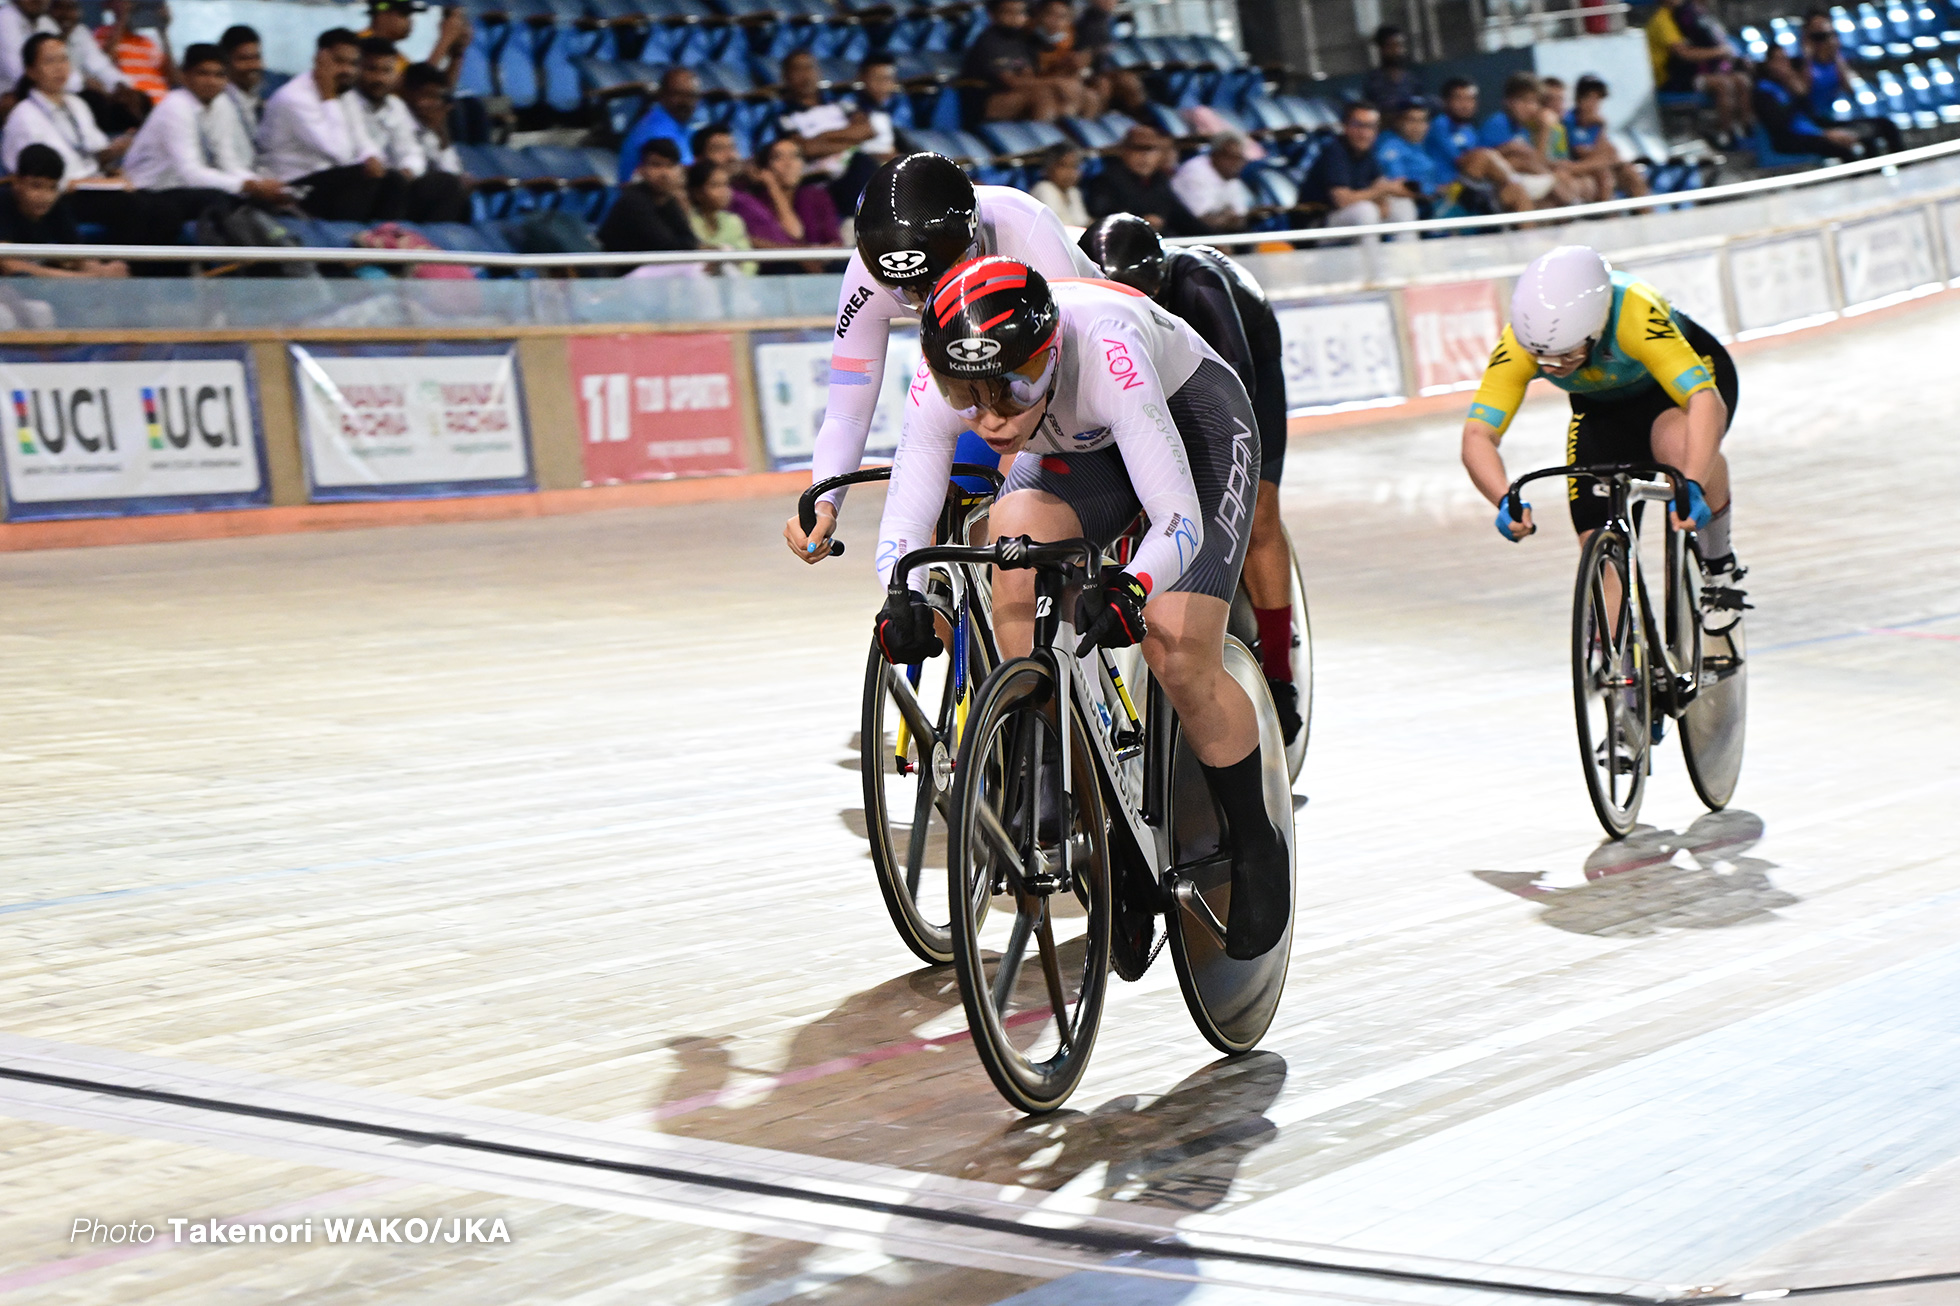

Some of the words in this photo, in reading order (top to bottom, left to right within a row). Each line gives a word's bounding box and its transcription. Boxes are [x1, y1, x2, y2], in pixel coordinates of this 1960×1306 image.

[882, 266, 929, 279] Kabuto
[836, 285, 875, 339] KOREA
[949, 361, 1002, 372] Kabuto
[31, 387, 118, 454] UCI
[158, 384, 240, 449] UCI
[1214, 416, 1253, 565] JAPAN
[1163, 512, 1182, 539] KEIRIN
